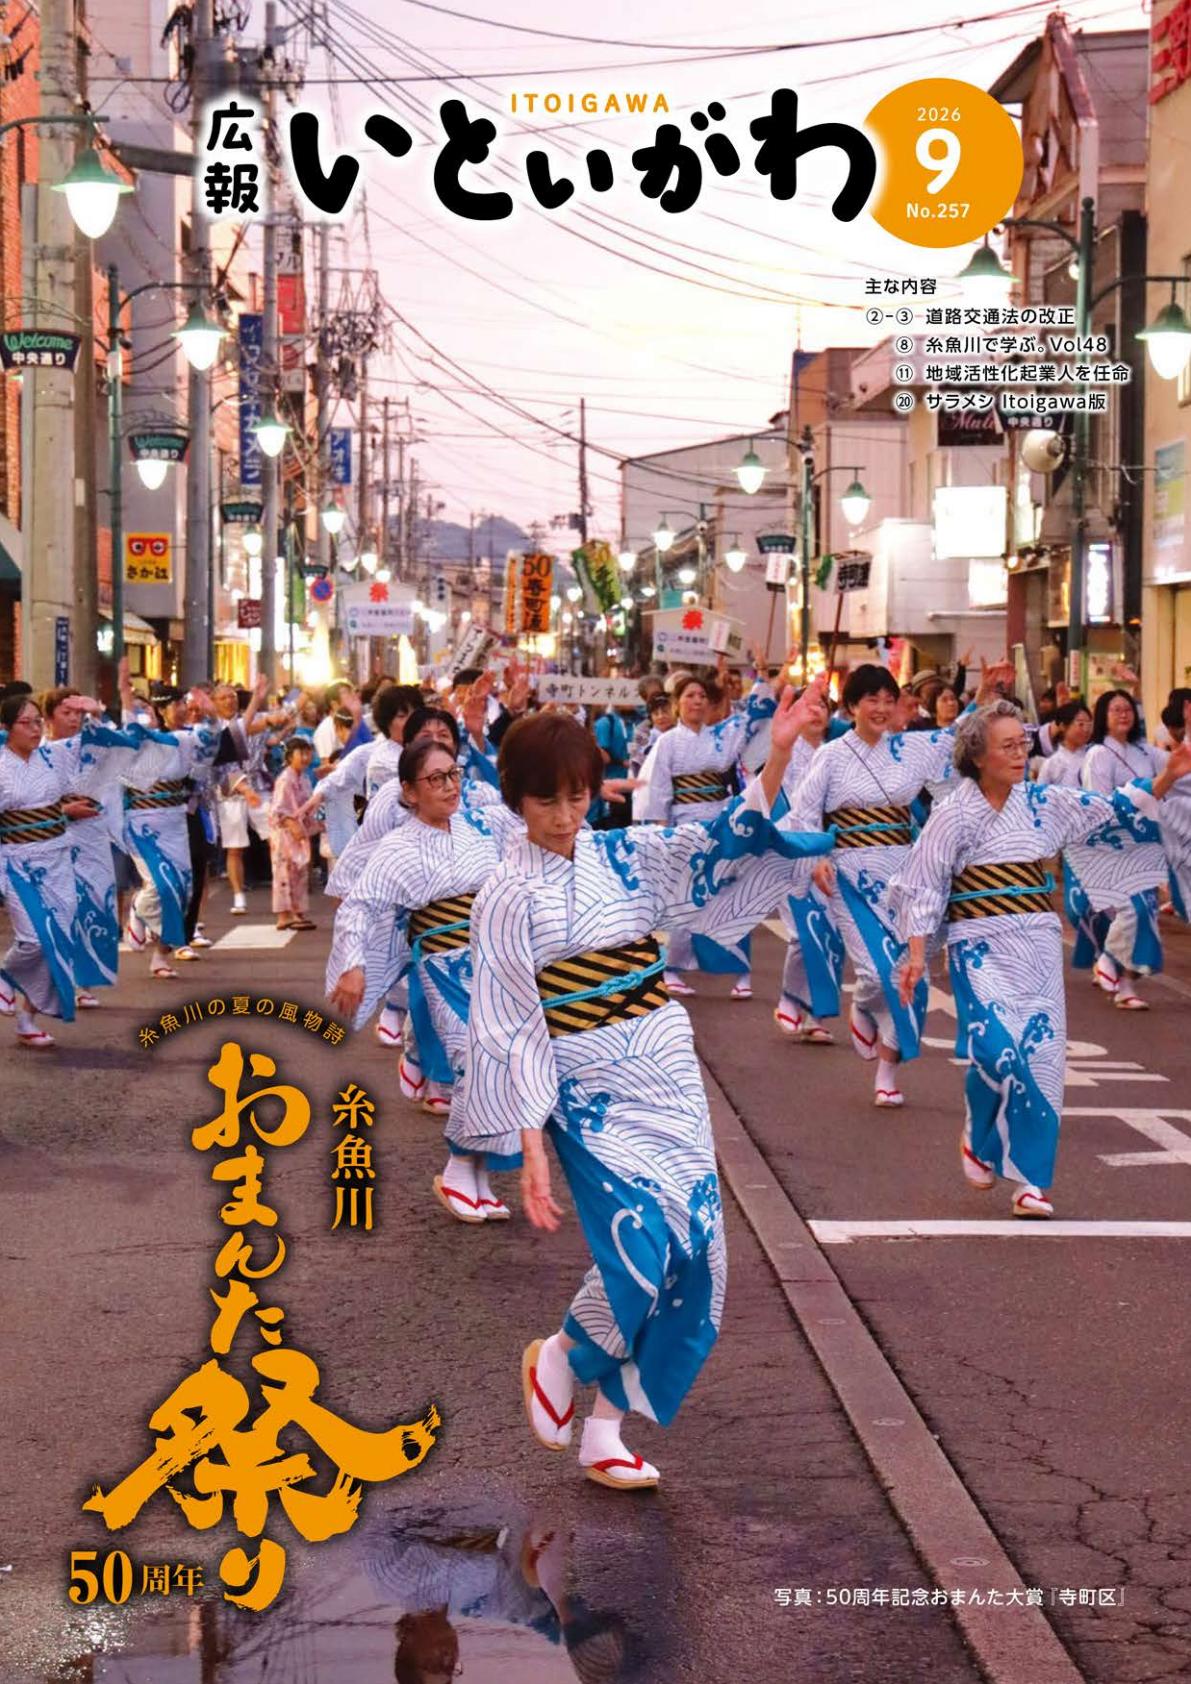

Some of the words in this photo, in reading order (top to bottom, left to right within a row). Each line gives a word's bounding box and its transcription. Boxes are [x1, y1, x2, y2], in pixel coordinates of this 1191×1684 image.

[4, 332, 74, 351] Welcome
[12, 352, 66, 366] 中央通り
[1006, 415, 1053, 428] 中央通り
